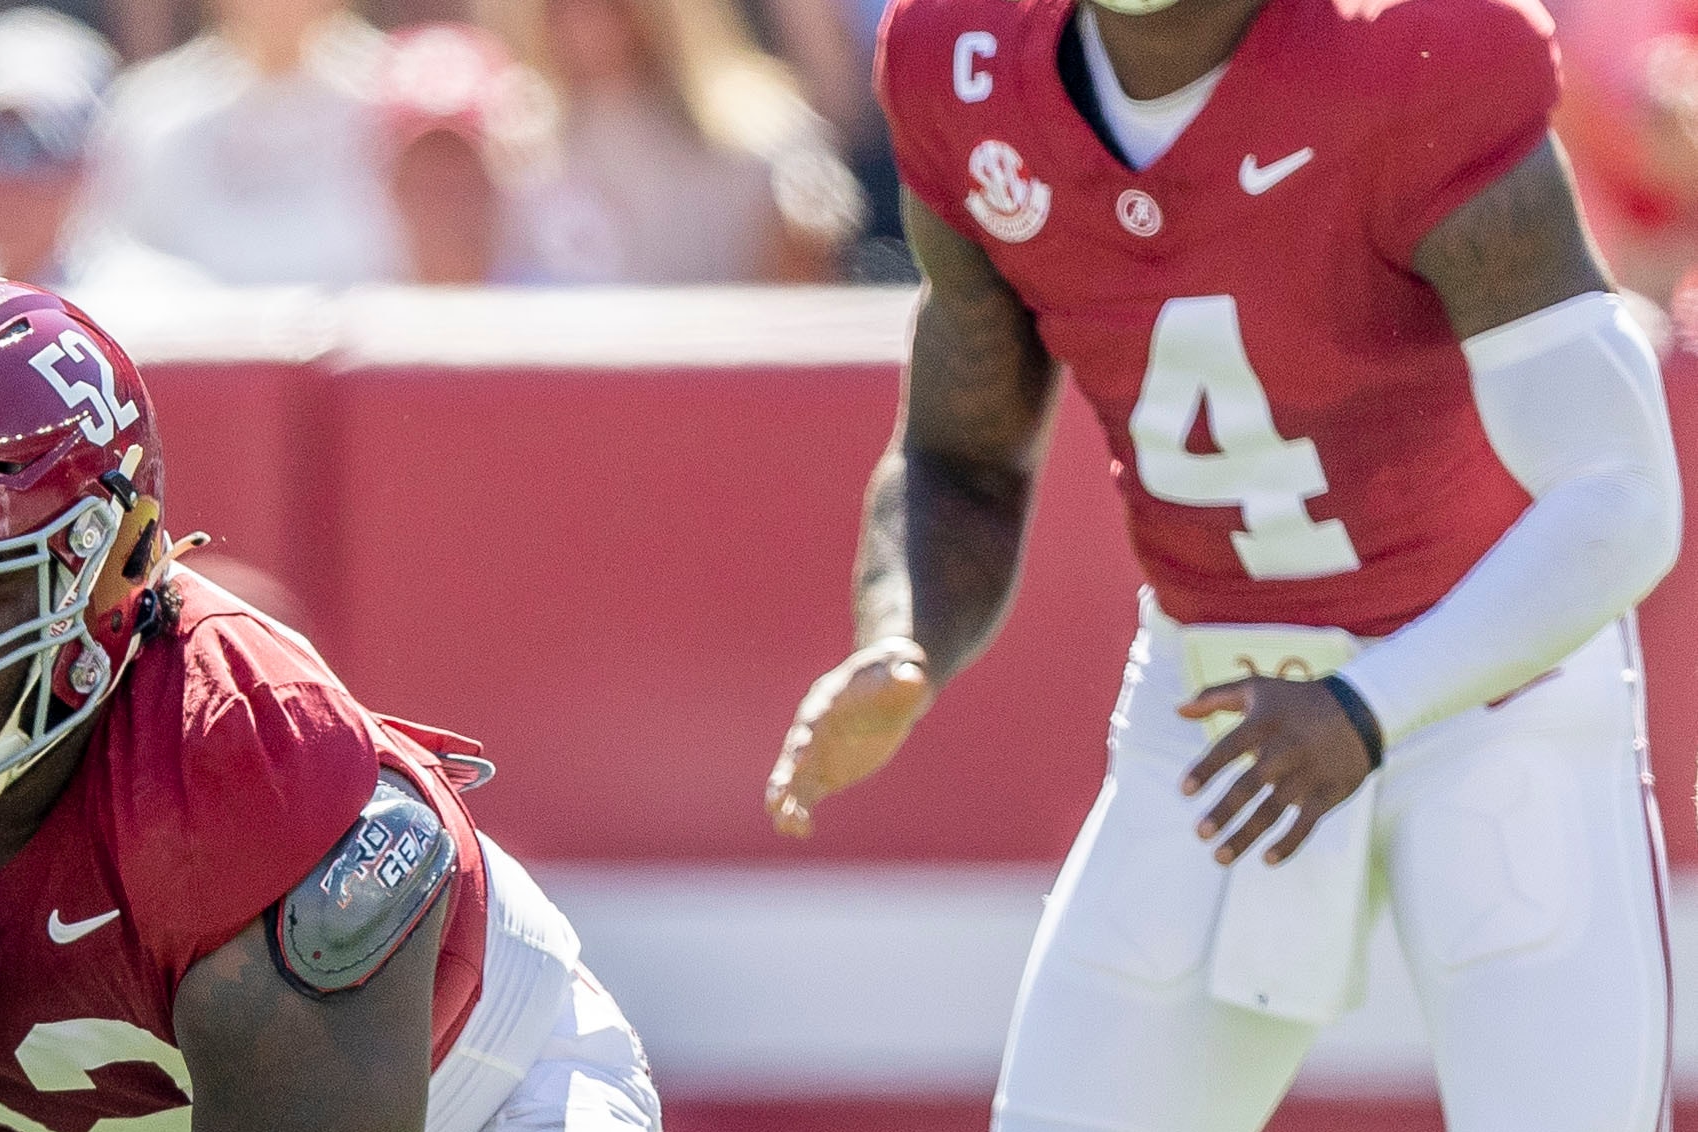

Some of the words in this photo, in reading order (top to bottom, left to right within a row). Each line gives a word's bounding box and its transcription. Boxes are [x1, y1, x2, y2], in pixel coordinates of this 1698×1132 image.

[953, 31, 997, 104] C
[28, 329, 140, 447] 52
[1128, 293, 1363, 583] 4
